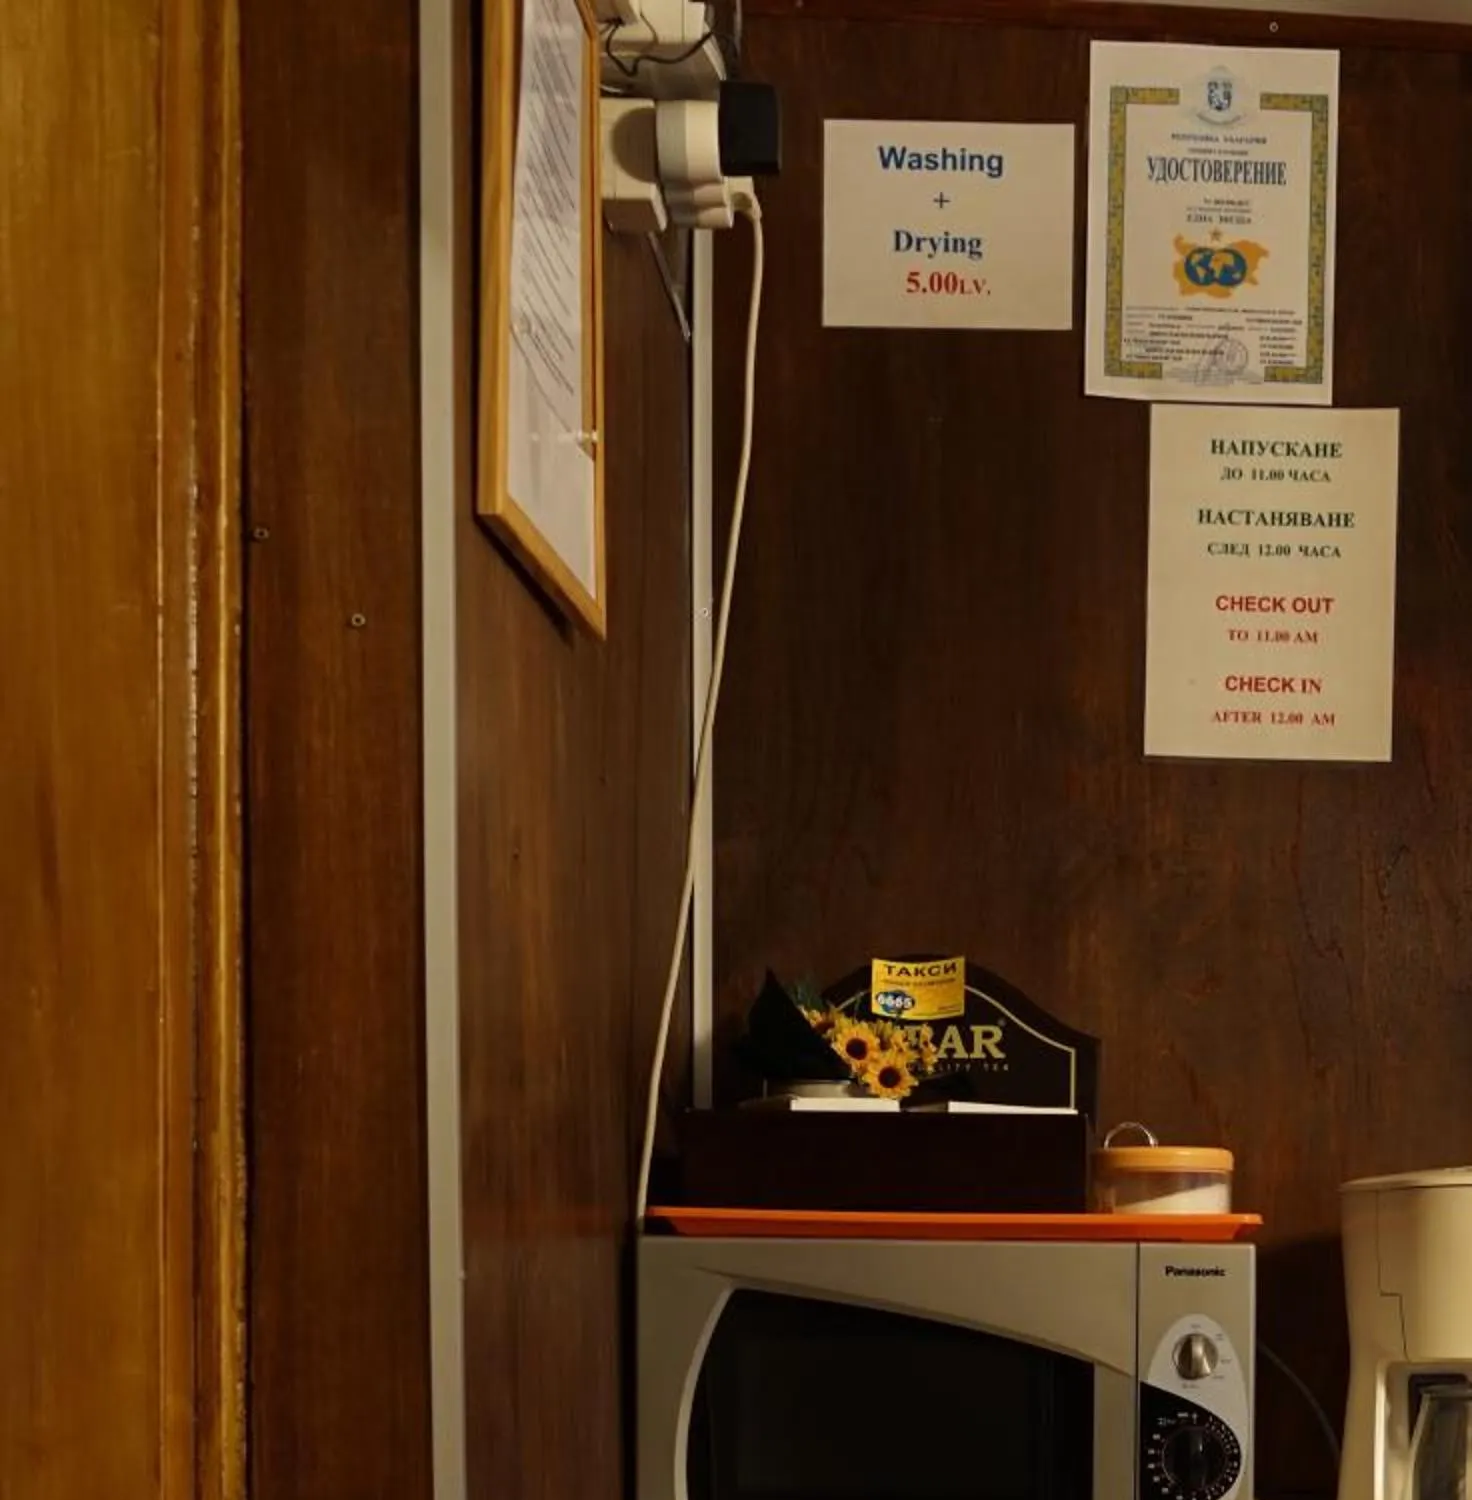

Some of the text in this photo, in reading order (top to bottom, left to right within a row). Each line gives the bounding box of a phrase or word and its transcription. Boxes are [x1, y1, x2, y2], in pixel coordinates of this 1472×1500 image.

[878, 145, 1004, 179] Washing
[1146, 155, 1287, 186] УДОСТОВЕРЕНИЕ
[932, 191, 951, 209] +
[893, 229, 983, 261] Drying
[1210, 438, 1343, 459] НАПУСКАНЕ
[1220, 467, 1332, 483] ДО 11.00 ЧАСА
[1198, 508, 1355, 529] НАСТАНЯВАНЕ
[1207, 542, 1342, 559] СЛЕД 12.00 ЧАСА
[1215, 595, 1335, 614] CHECK OUT
[1227, 629, 1319, 644] TO 11.00 AM
[1225, 675, 1323, 694] CHECK IN
[1212, 710, 1336, 726] AFTER 12.00 AM
[884, 961, 957, 977] ТАКСИ
[1164, 1265, 1226, 1277] Panasonic
